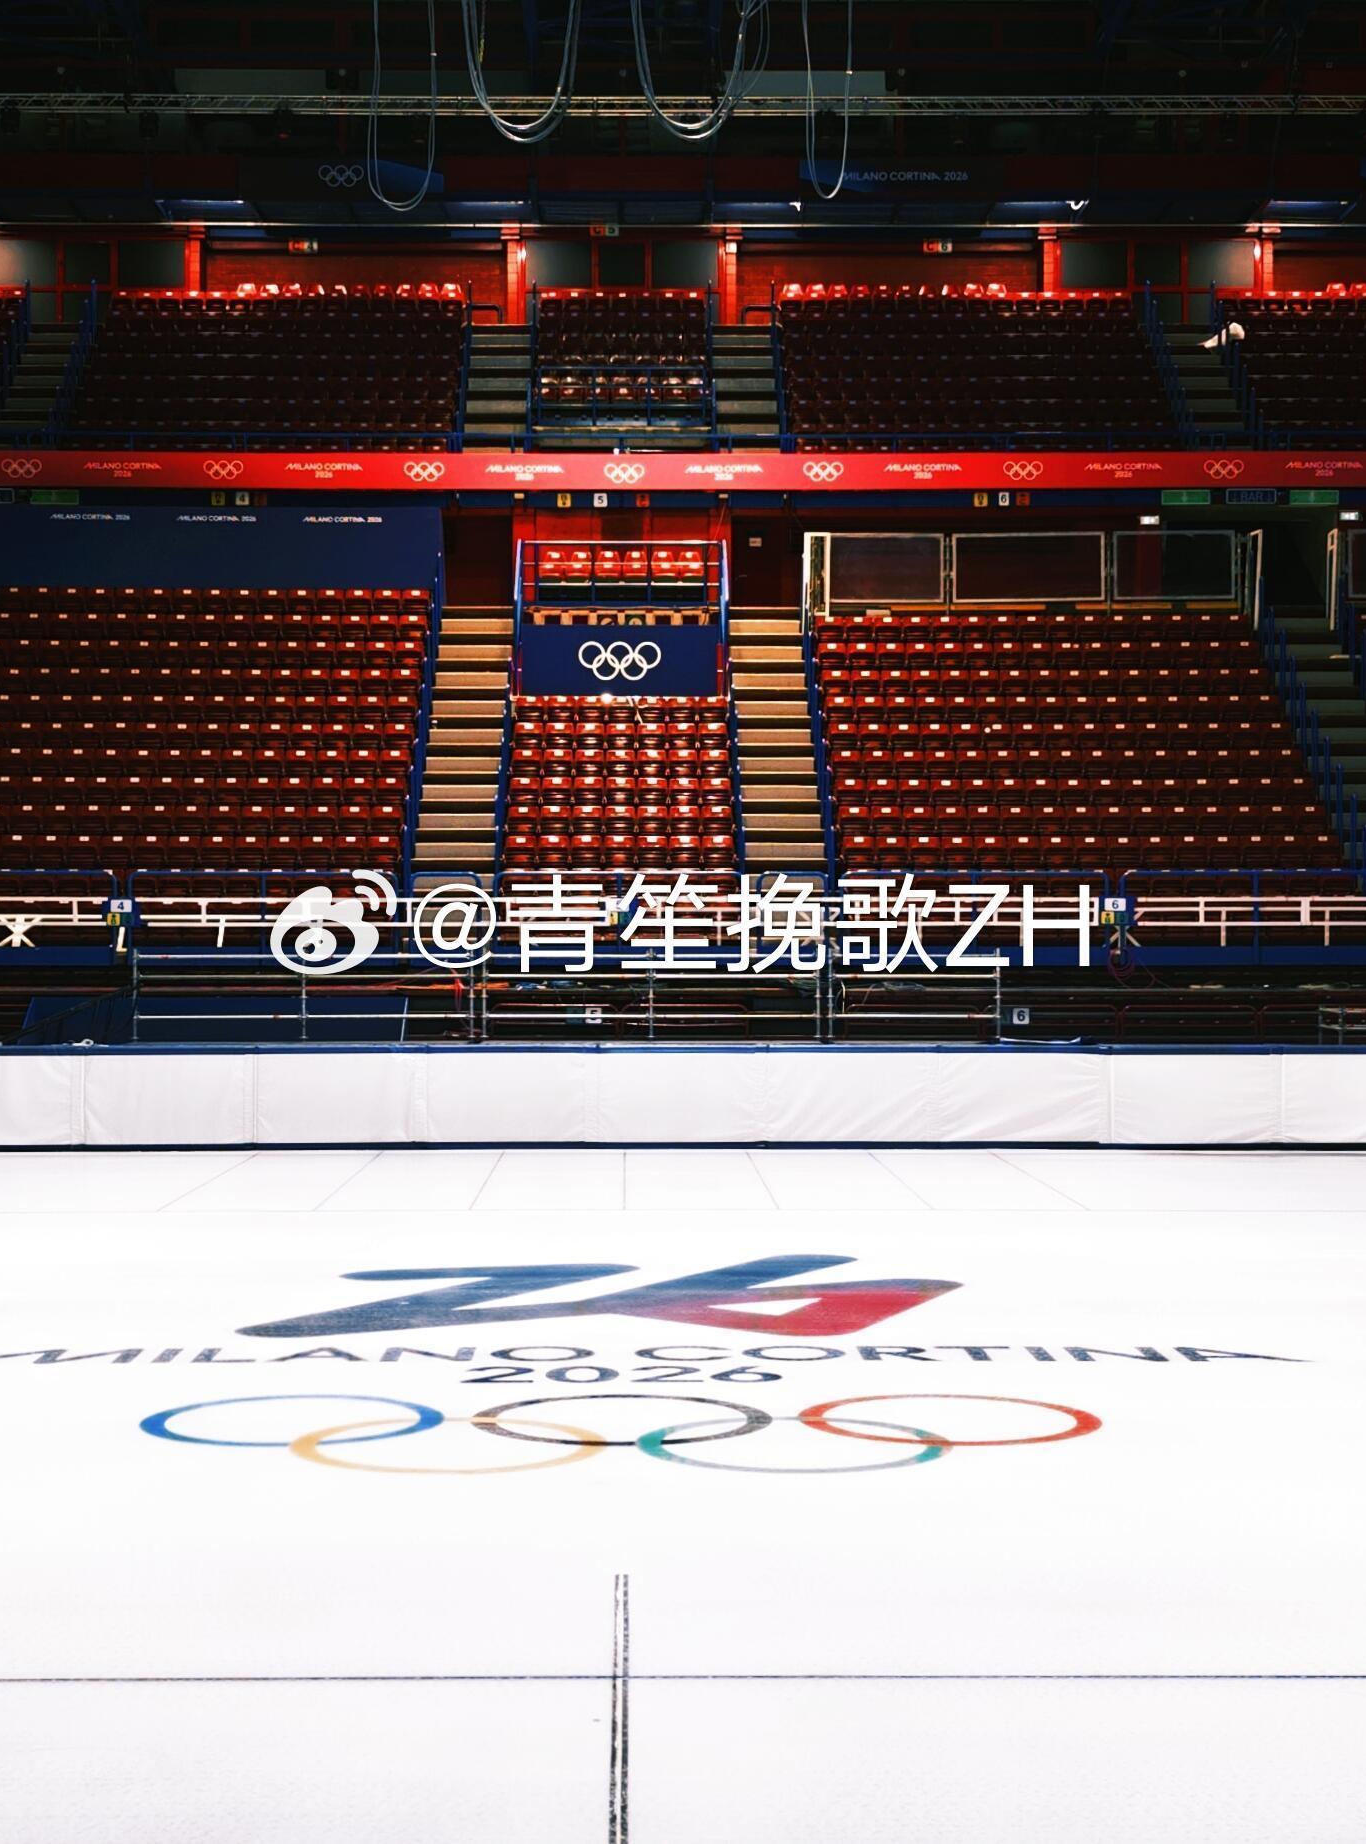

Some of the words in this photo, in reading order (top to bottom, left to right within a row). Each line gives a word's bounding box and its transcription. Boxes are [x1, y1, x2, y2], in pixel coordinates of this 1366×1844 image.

[843, 171, 888, 181] MILANO
[889, 171, 941, 181] CORTINA
[943, 171, 968, 181] 2026
[84, 462, 122, 470] MILANO
[123, 462, 163, 470] CORTINA
[285, 463, 323, 471] MILANO
[324, 463, 364, 471] CORTINA
[486, 465, 523, 473] MILANO
[524, 465, 564, 473] CORTINA
[686, 464, 723, 473] MILANO
[724, 464, 764, 473] CORTINA
[884, 464, 922, 472] MILANO
[923, 464, 963, 472] CORTINA
[1084, 462, 1122, 470] MILANO
[1123, 462, 1163, 470] CORTINA
[1284, 461, 1322, 469] MILANO
[1323, 461, 1363, 469] CORTINA
[1240, 493, 1263, 501] BAR
[1017, 1010, 1025, 1021] 6
[635, 1345, 1315, 1363] CORTINA
[460, 1366, 783, 1384] 2026
